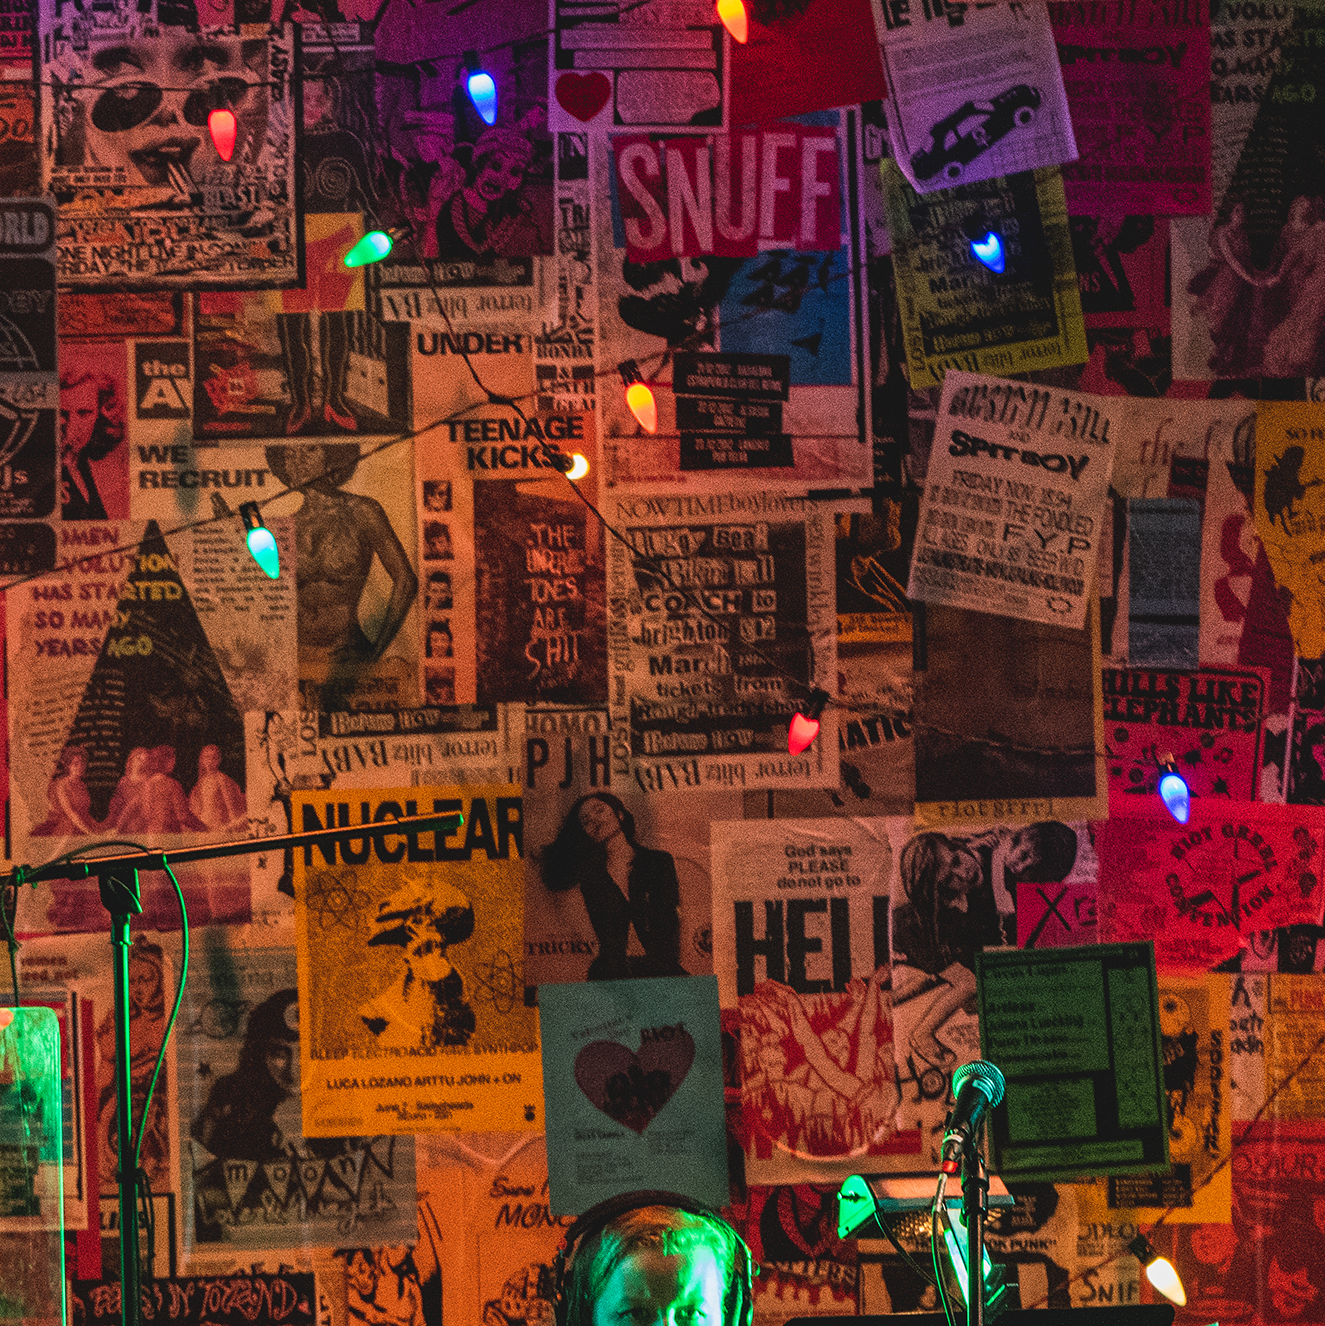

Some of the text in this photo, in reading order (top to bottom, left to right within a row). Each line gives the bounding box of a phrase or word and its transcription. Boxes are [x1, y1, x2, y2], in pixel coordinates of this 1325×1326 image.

[617, 131, 839, 254] SNUFF
[418, 332, 522, 355] UNDER
[141, 359, 187, 377] the
[449, 417, 584, 444] TEENAGE
[138, 444, 190, 464] WE
[467, 446, 563, 470] KICKS
[948, 430, 1091, 480] SPITBOY
[139, 469, 270, 489] RECRUIT
[32, 581, 182, 601] HAS STARTED
[645, 592, 743, 614] COACH
[35, 611, 130, 630] SO MANY
[36, 637, 153, 658] YEARS AGO
[649, 653, 727, 676] March
[1199, 678, 1258, 704] LIKE
[302, 797, 523, 866] NUCLEAR
[785, 842, 853, 860] God says
[787, 858, 851, 875] PLEASE
[327, 1079, 366, 1089] LUCA
[368, 1077, 410, 1088] LOZANO
[412, 1076, 455, 1086] ARTTU
[458, 1075, 489, 1085] JOHN
[504, 1074, 520, 1083] ON
